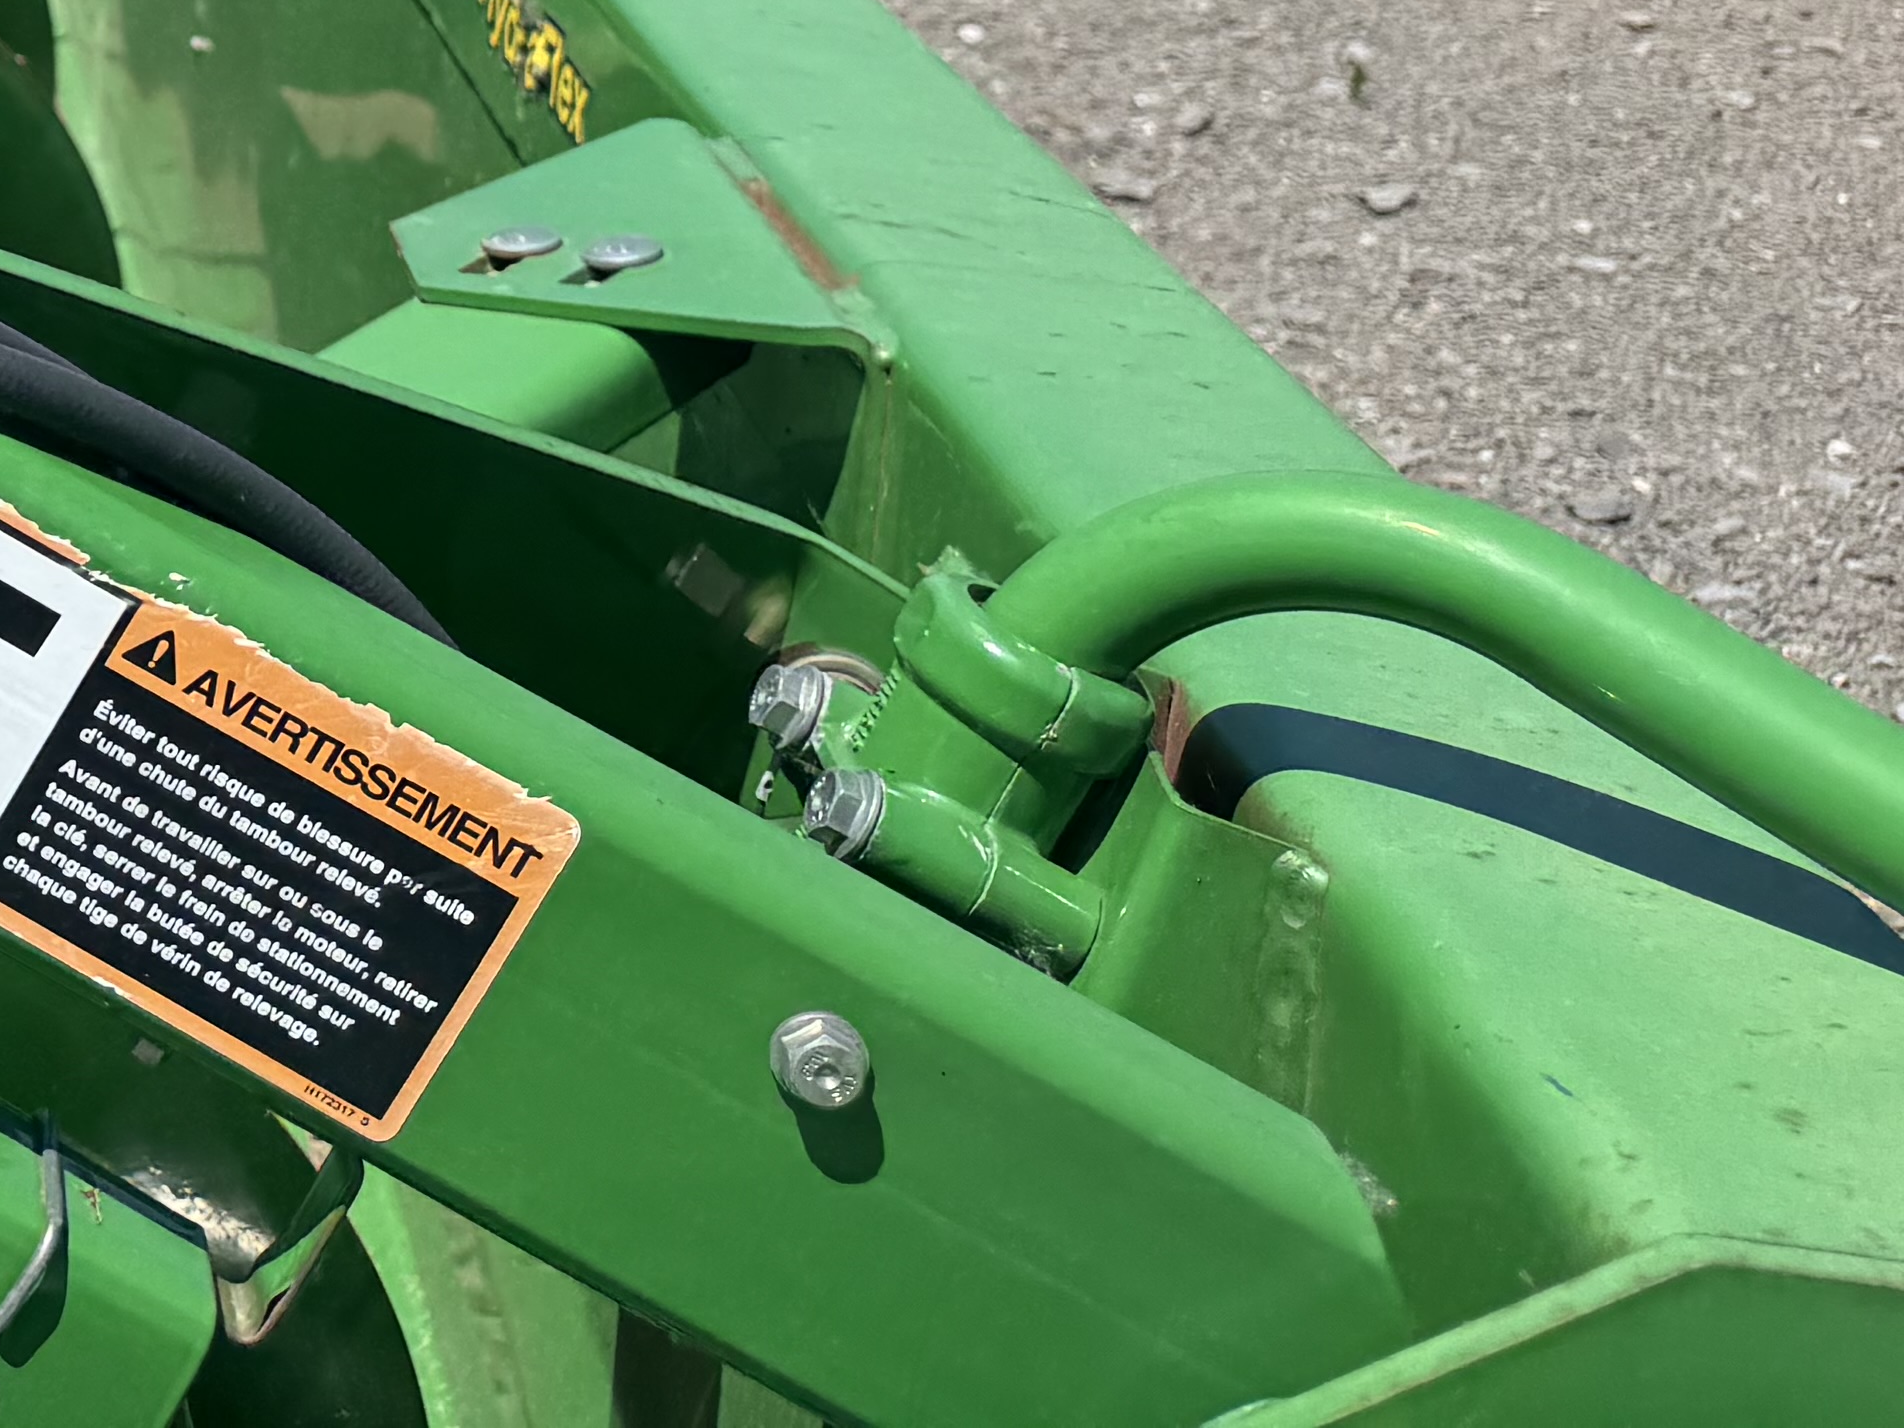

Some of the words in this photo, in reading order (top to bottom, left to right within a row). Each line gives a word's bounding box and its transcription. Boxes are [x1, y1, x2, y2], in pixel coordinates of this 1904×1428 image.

[56, 758, 122, 804] Avant
[120, 795, 150, 819] de
[149, 808, 242, 870] travailler
[239, 863, 279, 890] sur
[277, 884, 309, 909] ou
[308, 901, 361, 939] sous
[360, 927, 384, 951] le
[77, 726, 137, 768] d'une
[137, 760, 197, 802] chute
[197, 794, 229, 819] du
[227, 809, 317, 867] tambour
[314, 860, 382, 909] relevé.
[92, 697, 157, 744] Éviter
[154, 734, 200, 771] tout
[198, 762, 266, 808] risque
[266, 800, 296, 825] de
[295, 813, 385, 875] blessure
[421, 888, 475, 926] suite
[182, 669, 544, 879] AVERTISSEMENT
[1, 854, 78, 905] chaque
[77, 894, 119, 929] tige
[118, 921, 148, 946] de
[149, 937, 202, 977] vérin
[201, 969, 231, 993] de
[230, 985, 320, 1046] relevage.
[15, 830, 40, 853] et
[39, 844, 125, 899] engager
[122, 888, 146, 913] la
[144, 901, 205, 946] butée
[205, 939, 234, 963] de
[233, 956, 319, 1011] sécurité
[316, 1003, 356, 1031] sur
[29, 803, 52, 828] la
[52, 820, 88, 852] clé,
[91, 842, 156, 885] serrer
[153, 874, 177, 899] le
[176, 888, 227, 927] frein
[226, 919, 256, 943] de
[255, 936, 401, 1026] stationnement
[44, 780, 132, 839] tambour
[130, 832, 197, 883] relevé,
[200, 873, 273, 919] arrêter
[292, 925, 370, 980] moteur,
[372, 970, 439, 1014] retirer
